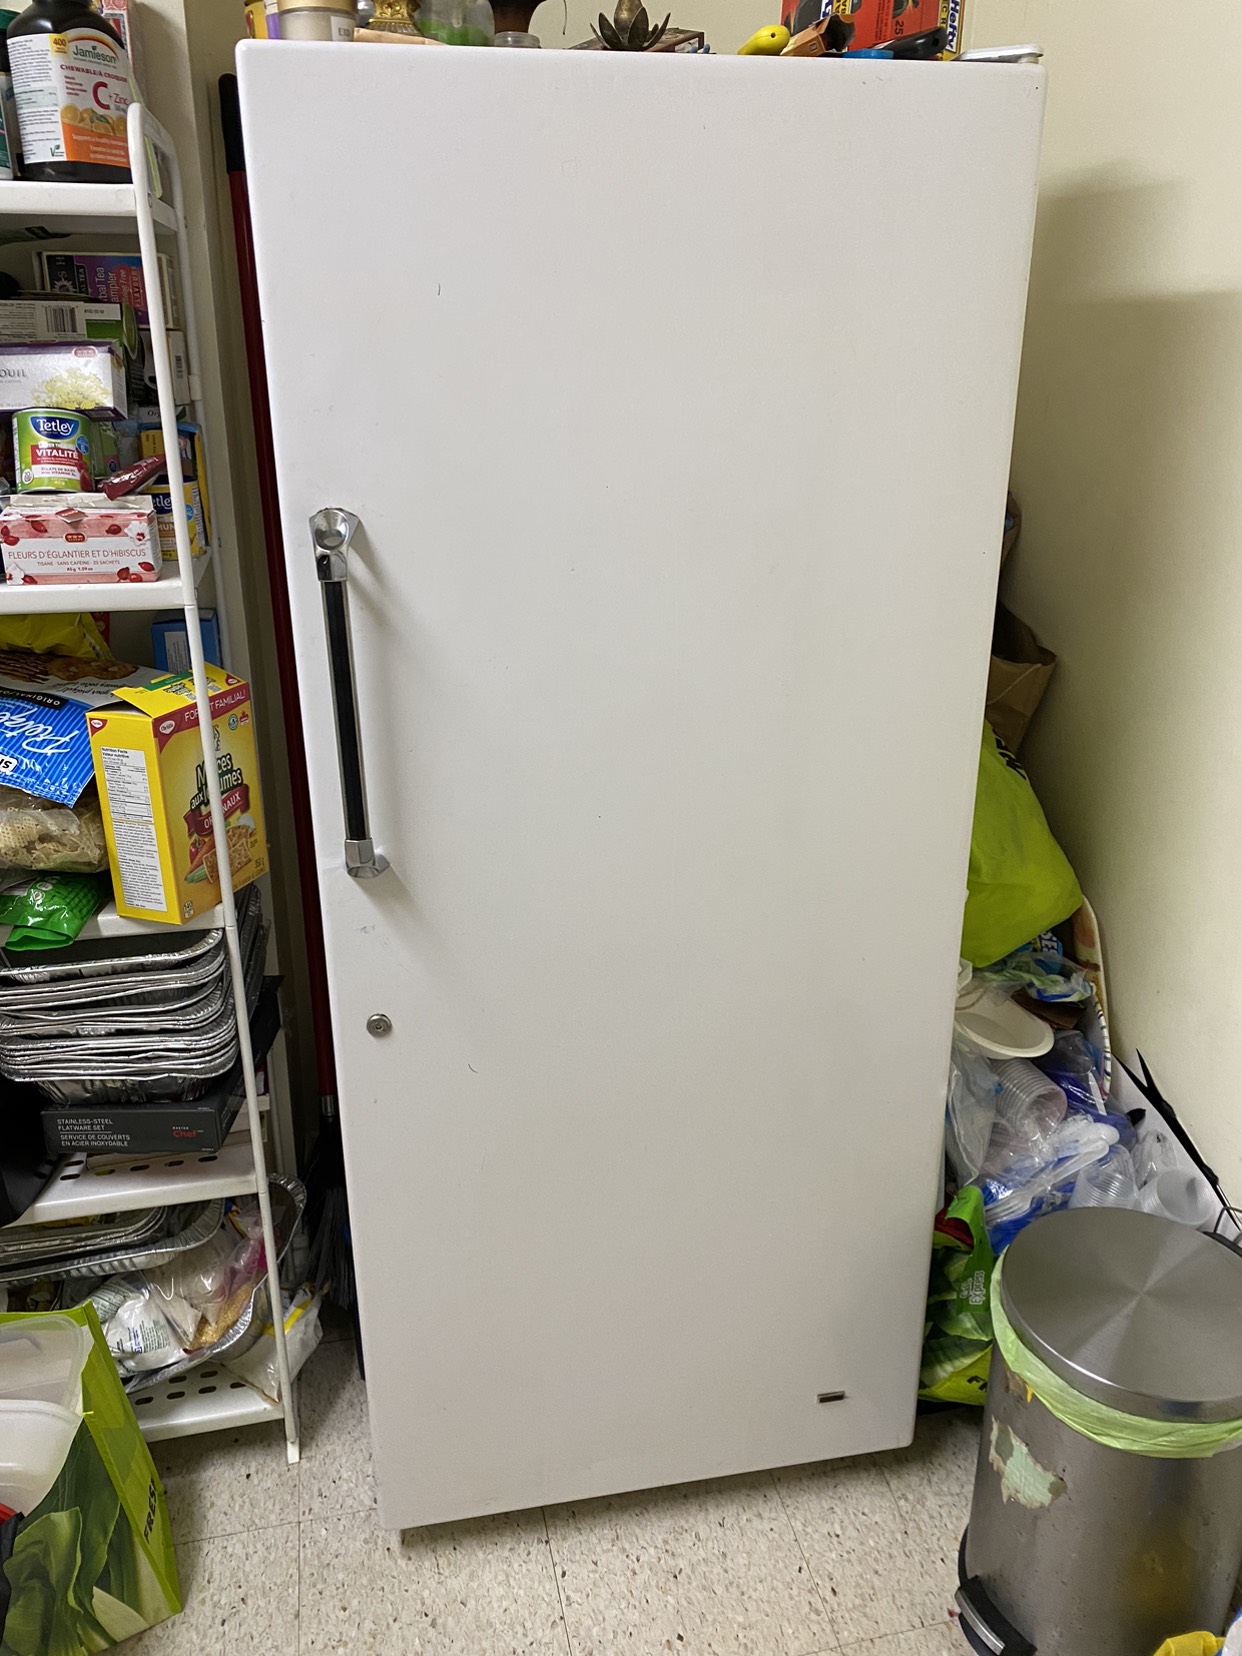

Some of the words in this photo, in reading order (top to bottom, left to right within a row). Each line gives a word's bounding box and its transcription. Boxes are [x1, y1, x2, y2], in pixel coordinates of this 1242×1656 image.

[895, 20, 904, 35] 25
[948, 0, 961, 48] Hefty
[53, 38, 67, 47] 400
[73, 45, 116, 64] Jamieson
[92, 81, 111, 110] C
[113, 92, 128, 106] Zinc
[95, 267, 105, 281] Tea
[108, 272, 119, 303] ampler
[36, 418, 74, 436] Tetley
[36, 449, 79, 459] VITALITÉ
[8, 551, 37, 559] FLEURS
[39, 549, 90, 559] D'ÉGLANTIER
[91, 550, 101, 558] ET
[102, 549, 146, 558] D'HIBISCUS
[214, 689, 246, 710] FAMILIAL!
[190, 791, 204, 810] aux
